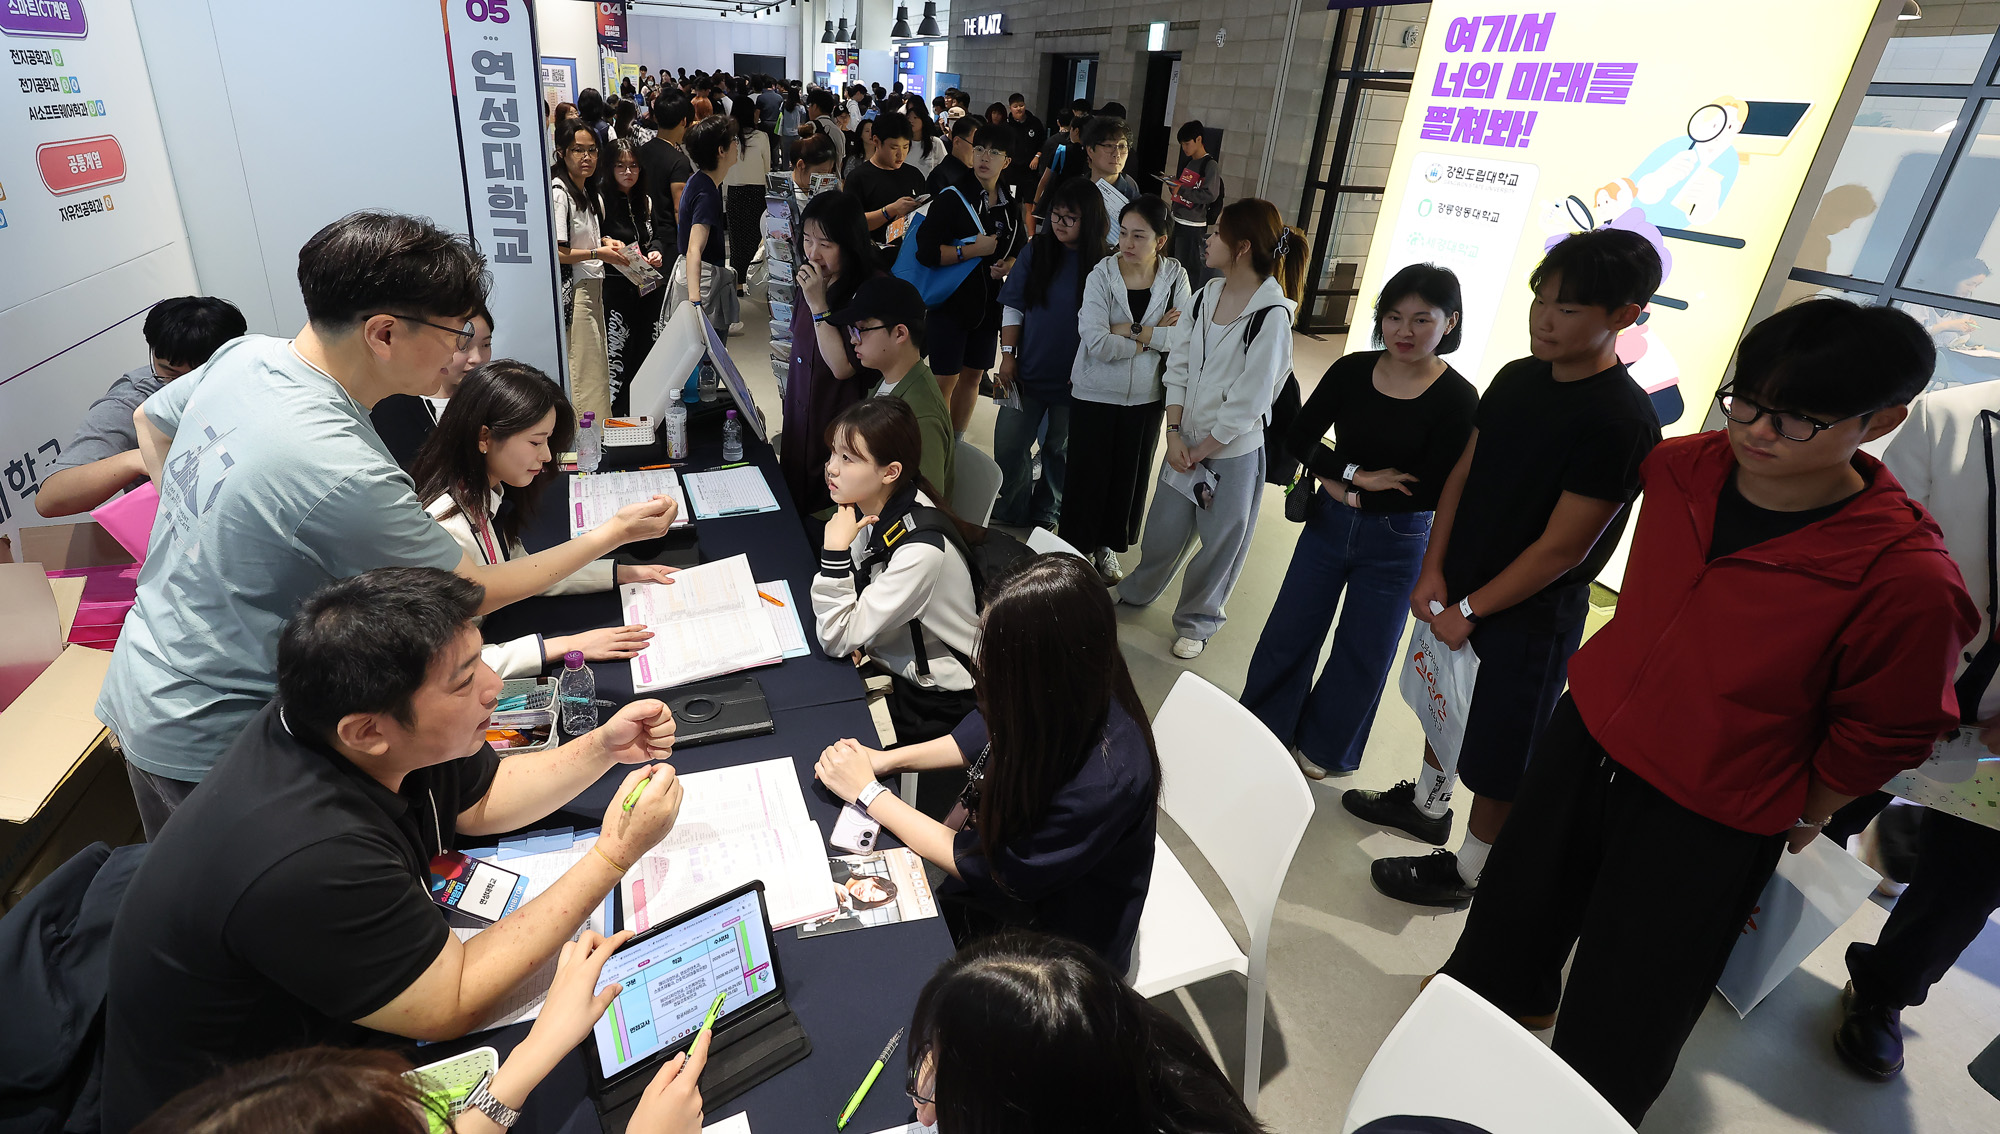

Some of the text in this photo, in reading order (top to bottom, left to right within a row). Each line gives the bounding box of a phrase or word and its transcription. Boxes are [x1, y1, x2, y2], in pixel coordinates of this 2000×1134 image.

[465, 0, 511, 24] 05
[600, 2, 623, 16] 04
[963, 13, 1002, 36] THE PLATZ
[1443, 12, 1557, 53] 여기서
[9, 49, 53, 65] 전자공학과
[18, 77, 60, 93] 전기공학과
[1431, 62, 1639, 105] 너의 미래를
[29, 102, 88, 121] AI소프트웨어학과
[1419, 105, 1538, 148] 펼쳐봐!
[66, 151, 103, 174] 공통계열
[471, 49, 533, 264] 연성대학교
[1446, 165, 1519, 187] 강원도립대학교
[59, 198, 104, 222] 자유전공학과
[1438, 202, 1500, 223] 강릉영동대학교
[447, 882, 466, 906] 박람회
[479, 878, 498, 905] 연성대학교
